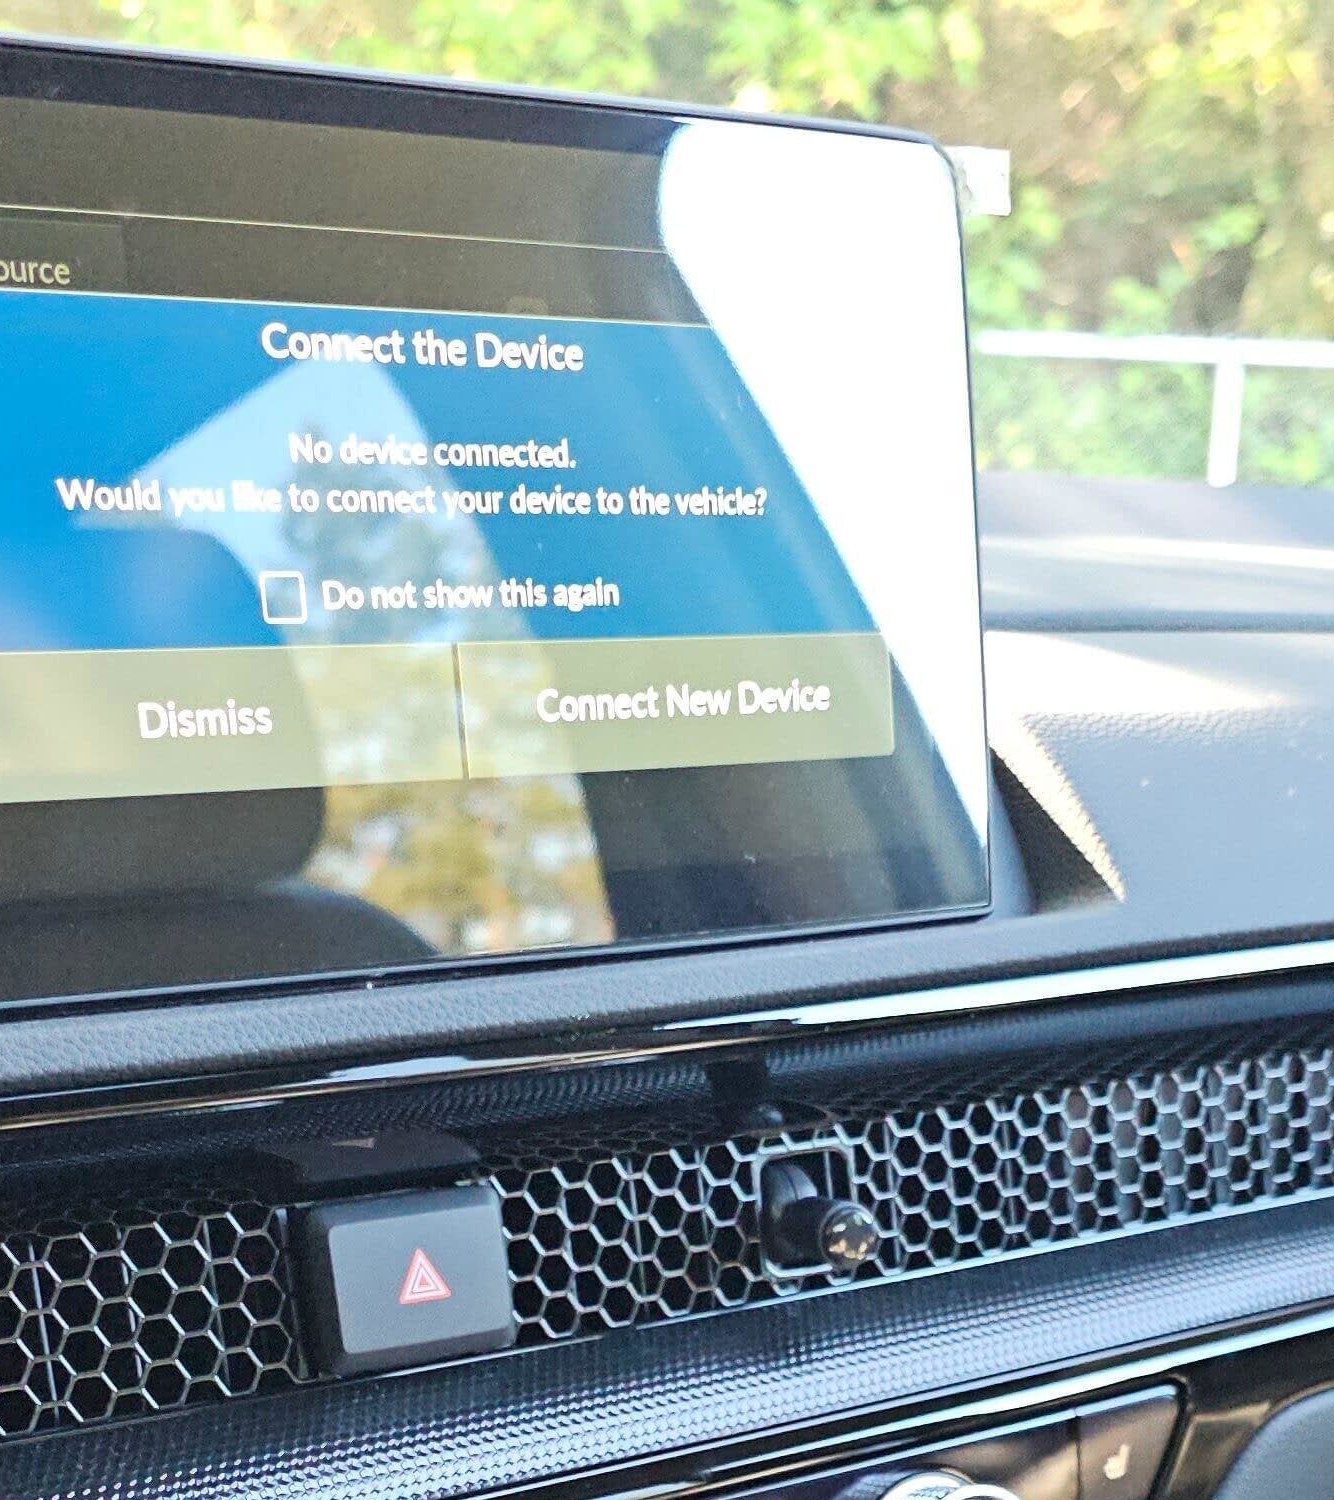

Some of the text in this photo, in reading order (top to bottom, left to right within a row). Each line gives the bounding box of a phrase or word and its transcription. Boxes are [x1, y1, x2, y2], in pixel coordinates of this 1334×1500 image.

[261, 322, 584, 371] Connect the Device
[288, 432, 577, 469] No device connected.
[56, 478, 767, 520] Would you like to connect your device to the vehicle?
[321, 576, 620, 612] Do not show this again
[137, 698, 273, 739] Dismiss
[536, 678, 831, 723] Connect New Device
